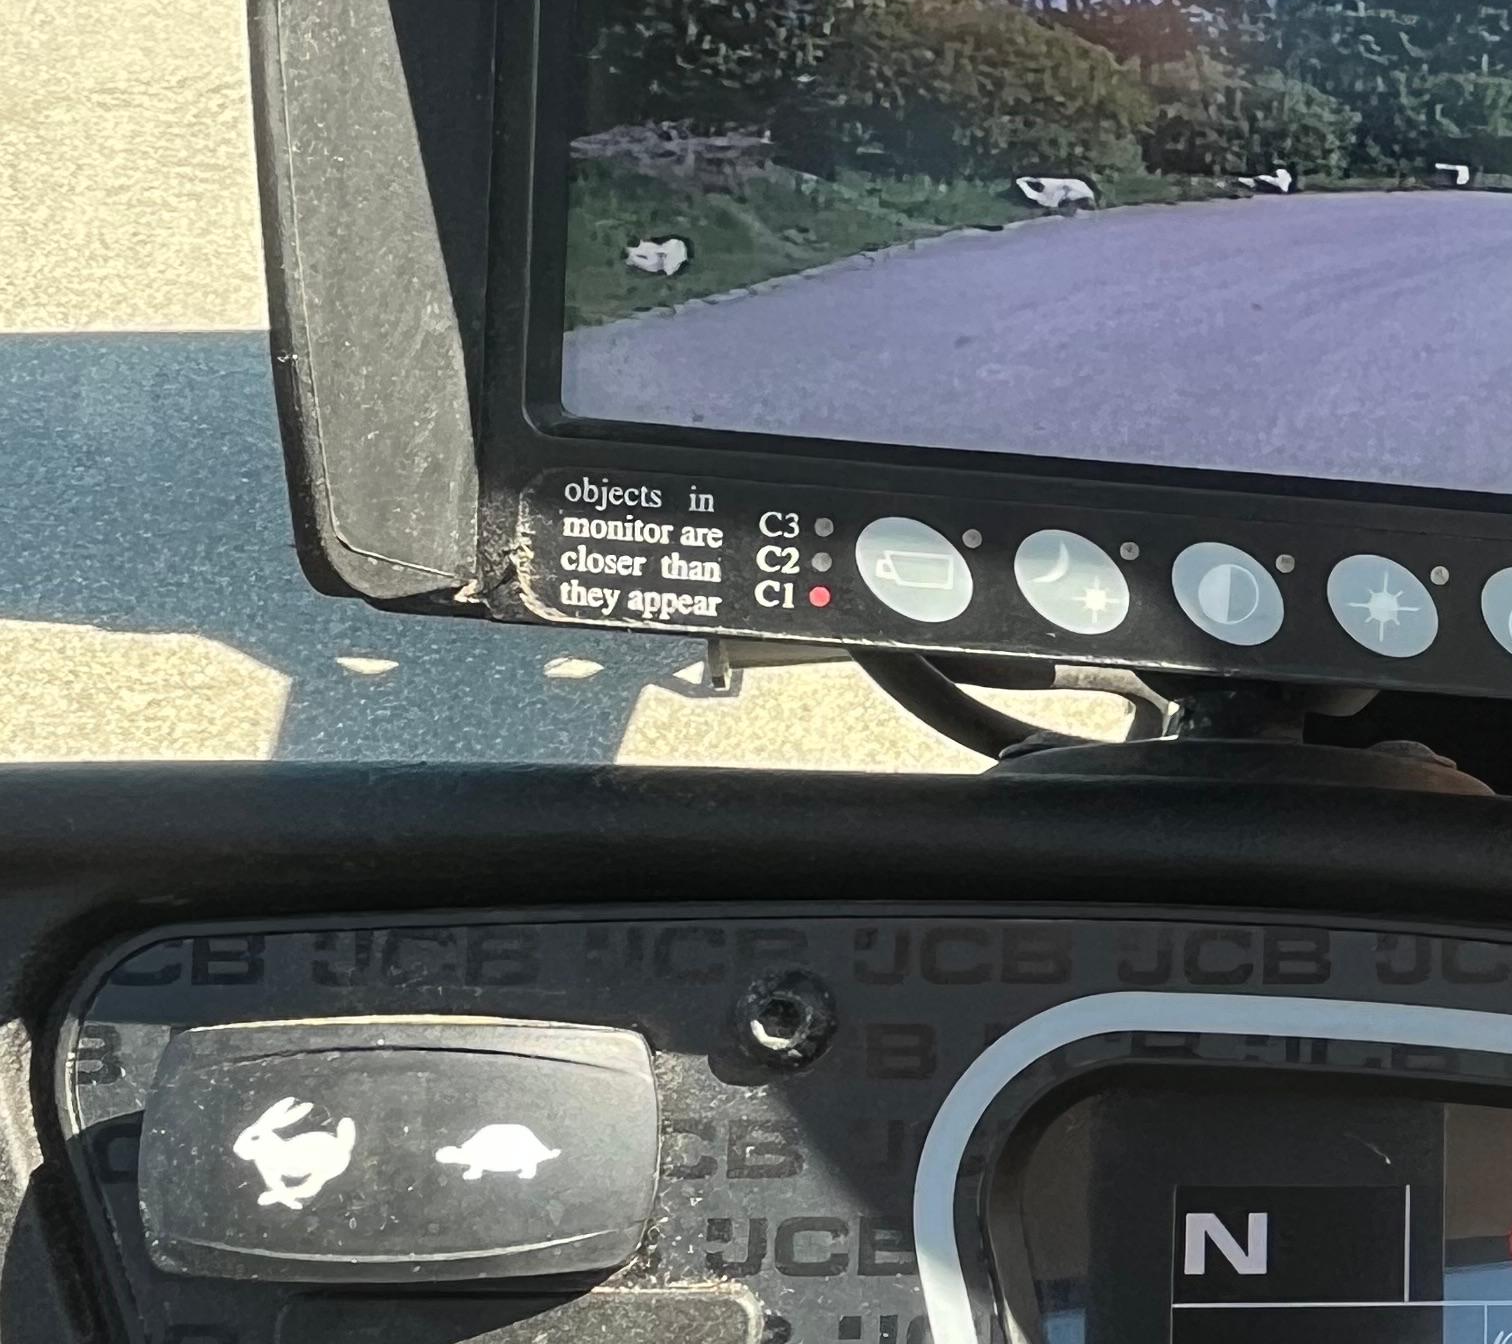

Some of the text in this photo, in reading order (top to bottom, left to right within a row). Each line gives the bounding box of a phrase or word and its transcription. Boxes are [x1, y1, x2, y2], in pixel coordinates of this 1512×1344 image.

[565, 477, 714, 512] objects in
[563, 515, 724, 548] monitor are
[759, 511, 800, 538] C3
[560, 545, 722, 583] closer than
[756, 545, 800, 574] C2
[560, 580, 723, 619] they appear
[754, 580, 794, 608] C1
[852, 926, 1073, 985] JCB
[1117, 926, 1331, 986] JCB
[1184, 1212, 1268, 1275] N
